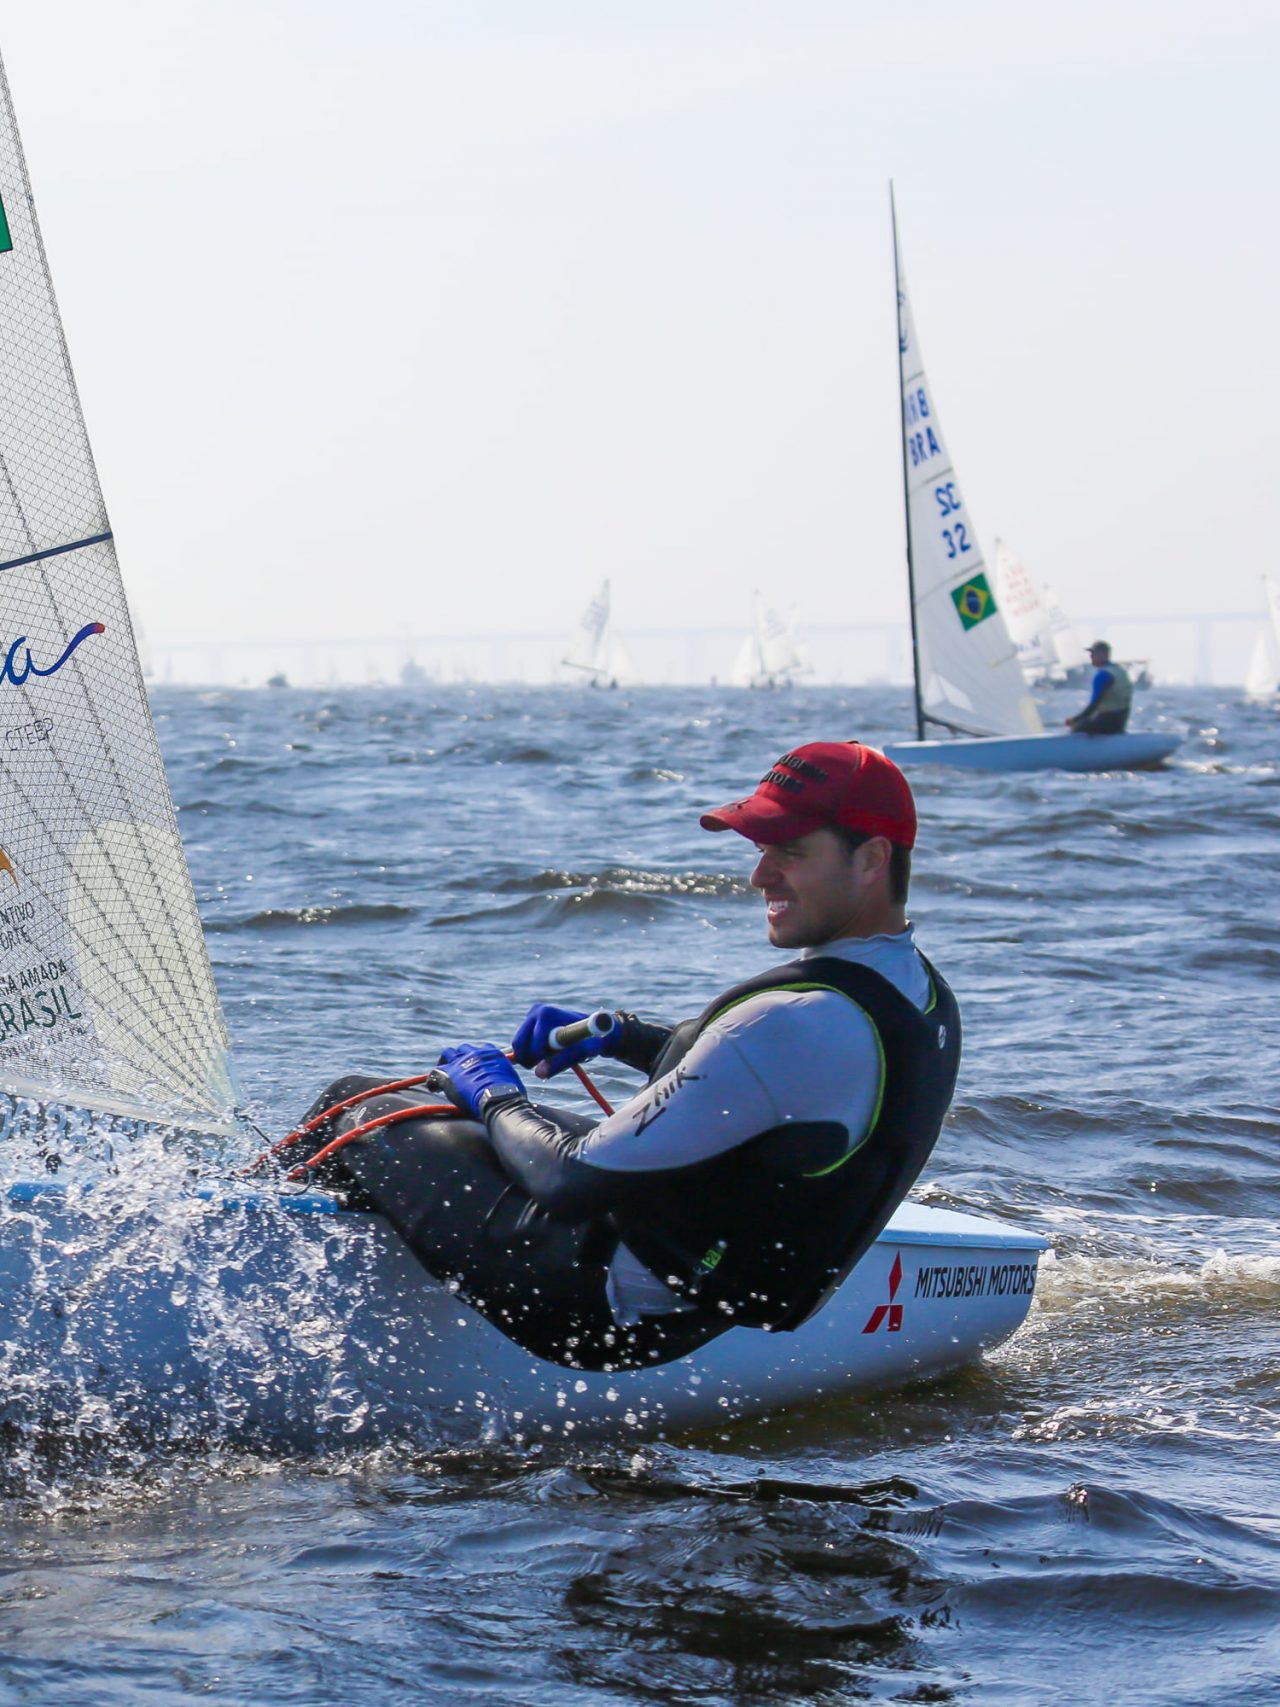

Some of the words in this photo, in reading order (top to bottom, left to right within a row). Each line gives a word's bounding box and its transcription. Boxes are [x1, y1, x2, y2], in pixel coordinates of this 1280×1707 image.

[909, 426, 941, 466] BRA
[942, 522, 971, 558] 32
[19, 957, 68, 990] AMADA
[914, 1265, 987, 1298] MITSUBISHI
[986, 1264, 1037, 1296] MOTORS
